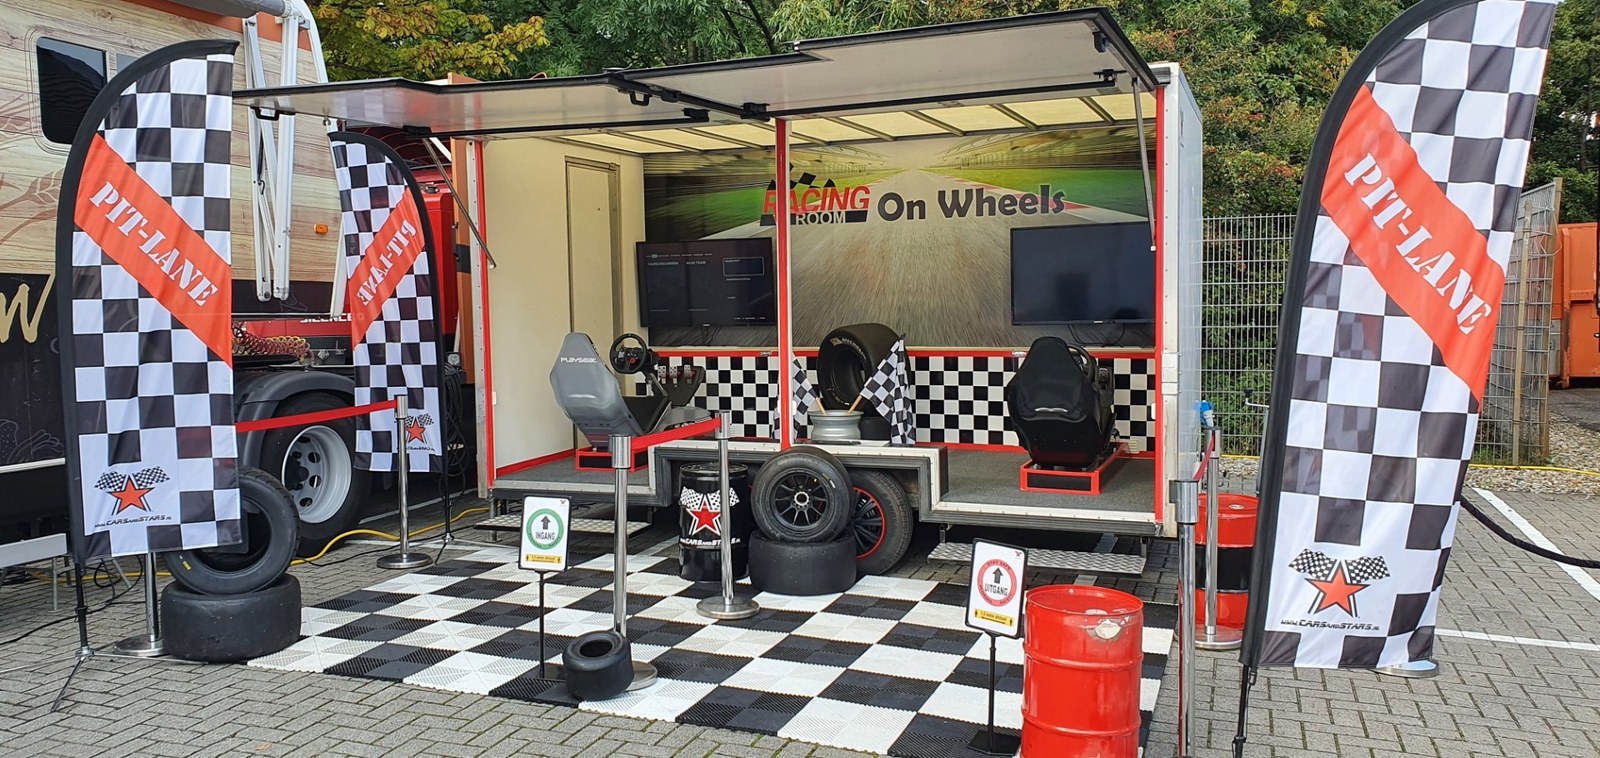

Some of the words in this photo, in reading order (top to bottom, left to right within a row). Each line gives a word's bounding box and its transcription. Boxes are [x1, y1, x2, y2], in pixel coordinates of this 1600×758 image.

[877, 192, 926, 222] On
[937, 184, 1066, 219] Wheels
[796, 212, 846, 225] ROOM
[89, 181, 218, 306] PIT-LANE
[1344, 153, 1492, 335] PIT-LANE
[535, 531, 555, 540] INGANG
[984, 584, 1008, 596] UITGANG
